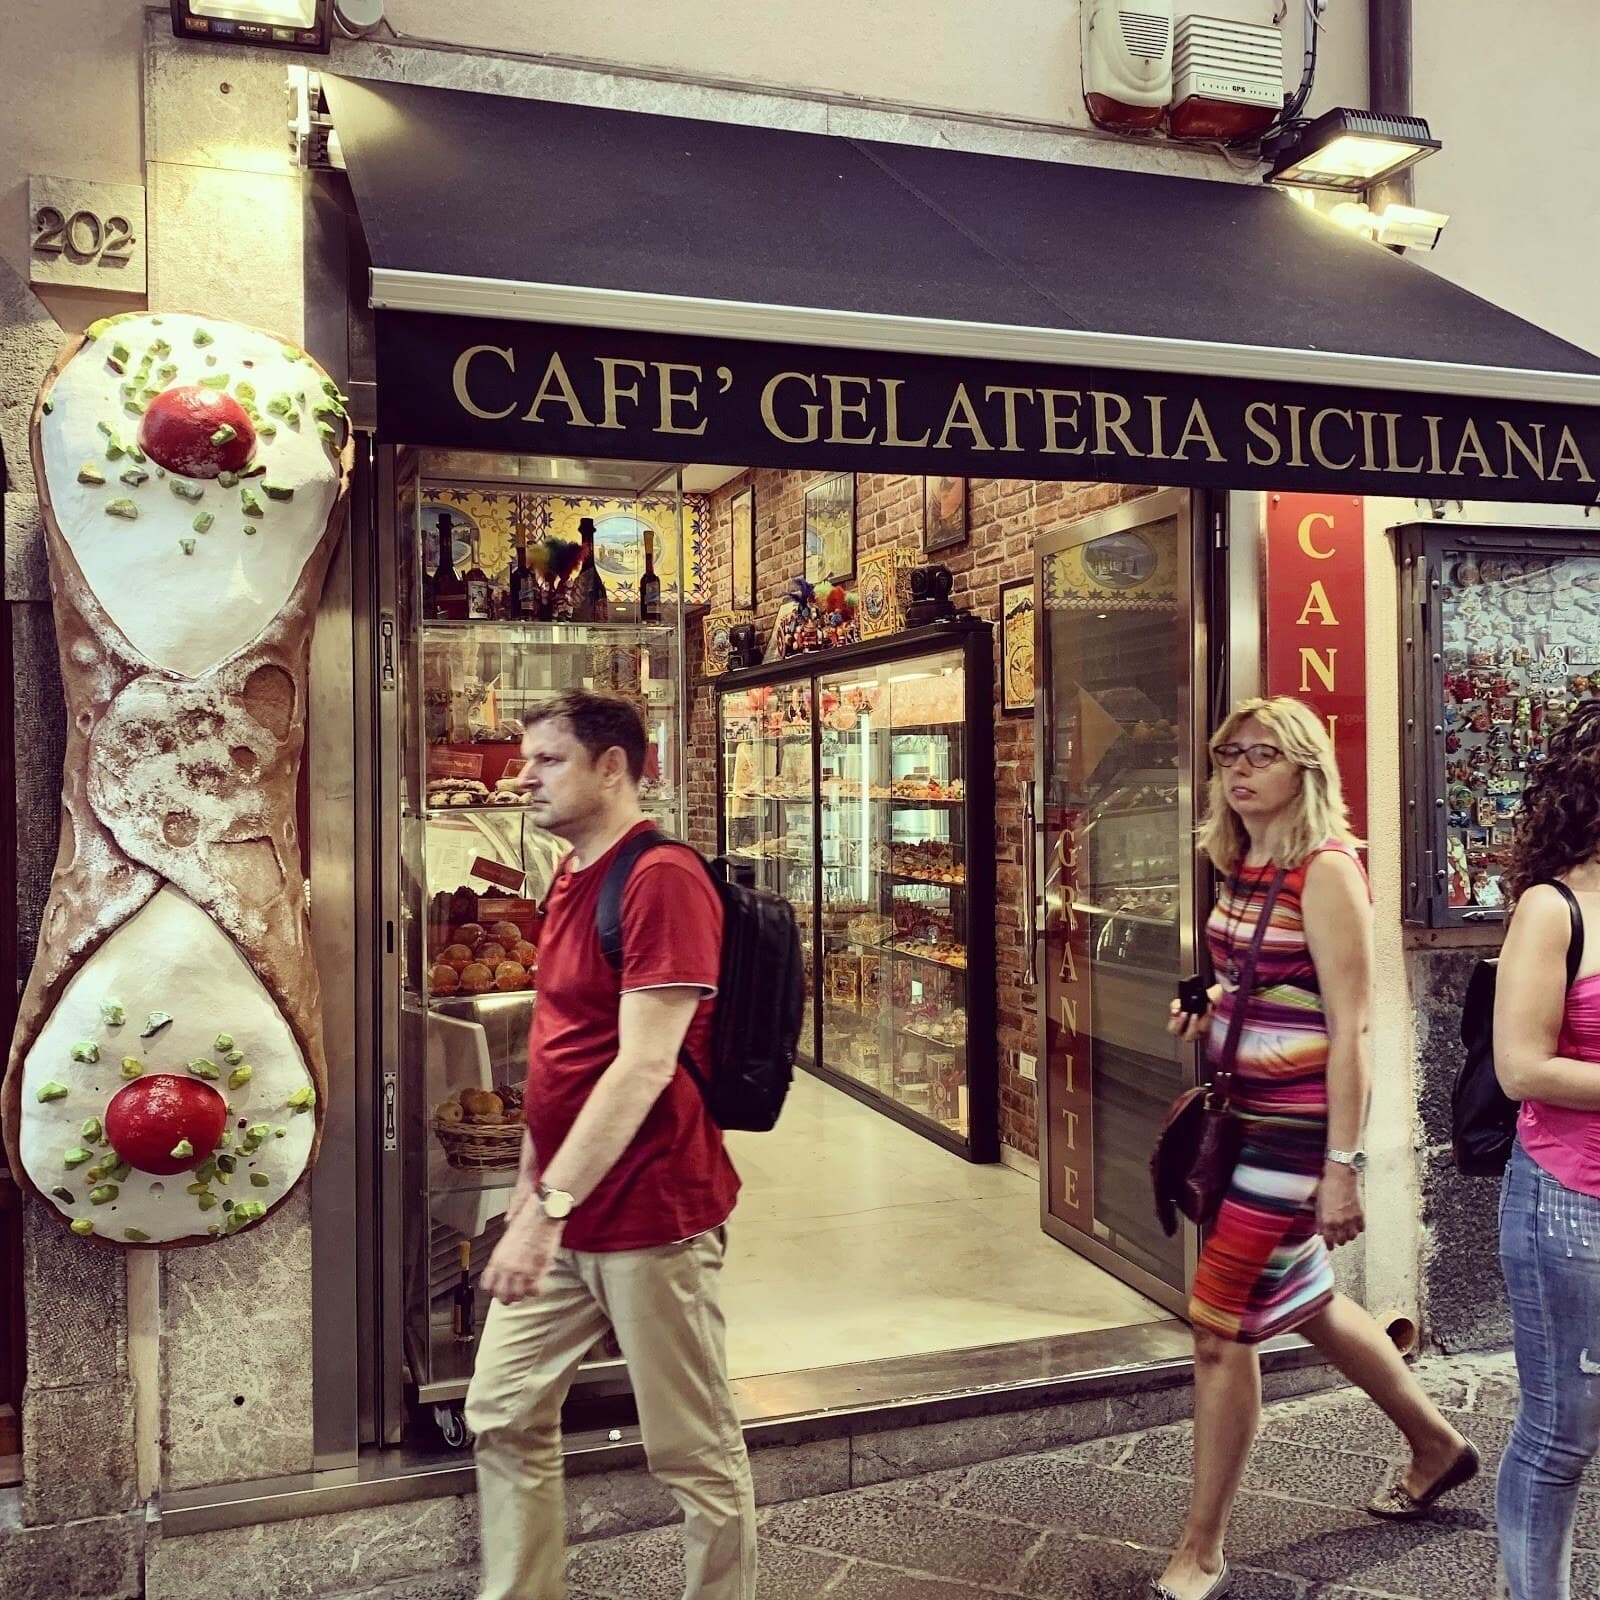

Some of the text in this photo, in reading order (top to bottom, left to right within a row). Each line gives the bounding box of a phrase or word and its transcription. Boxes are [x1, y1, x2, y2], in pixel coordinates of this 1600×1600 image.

[1232, 85, 1246, 93] GPS
[33, 206, 136, 258] 202
[760, 371, 1228, 463] GELATERIA
[1244, 402, 1597, 483] SICILIANA
[1056, 828, 1080, 1210] GRANITE
